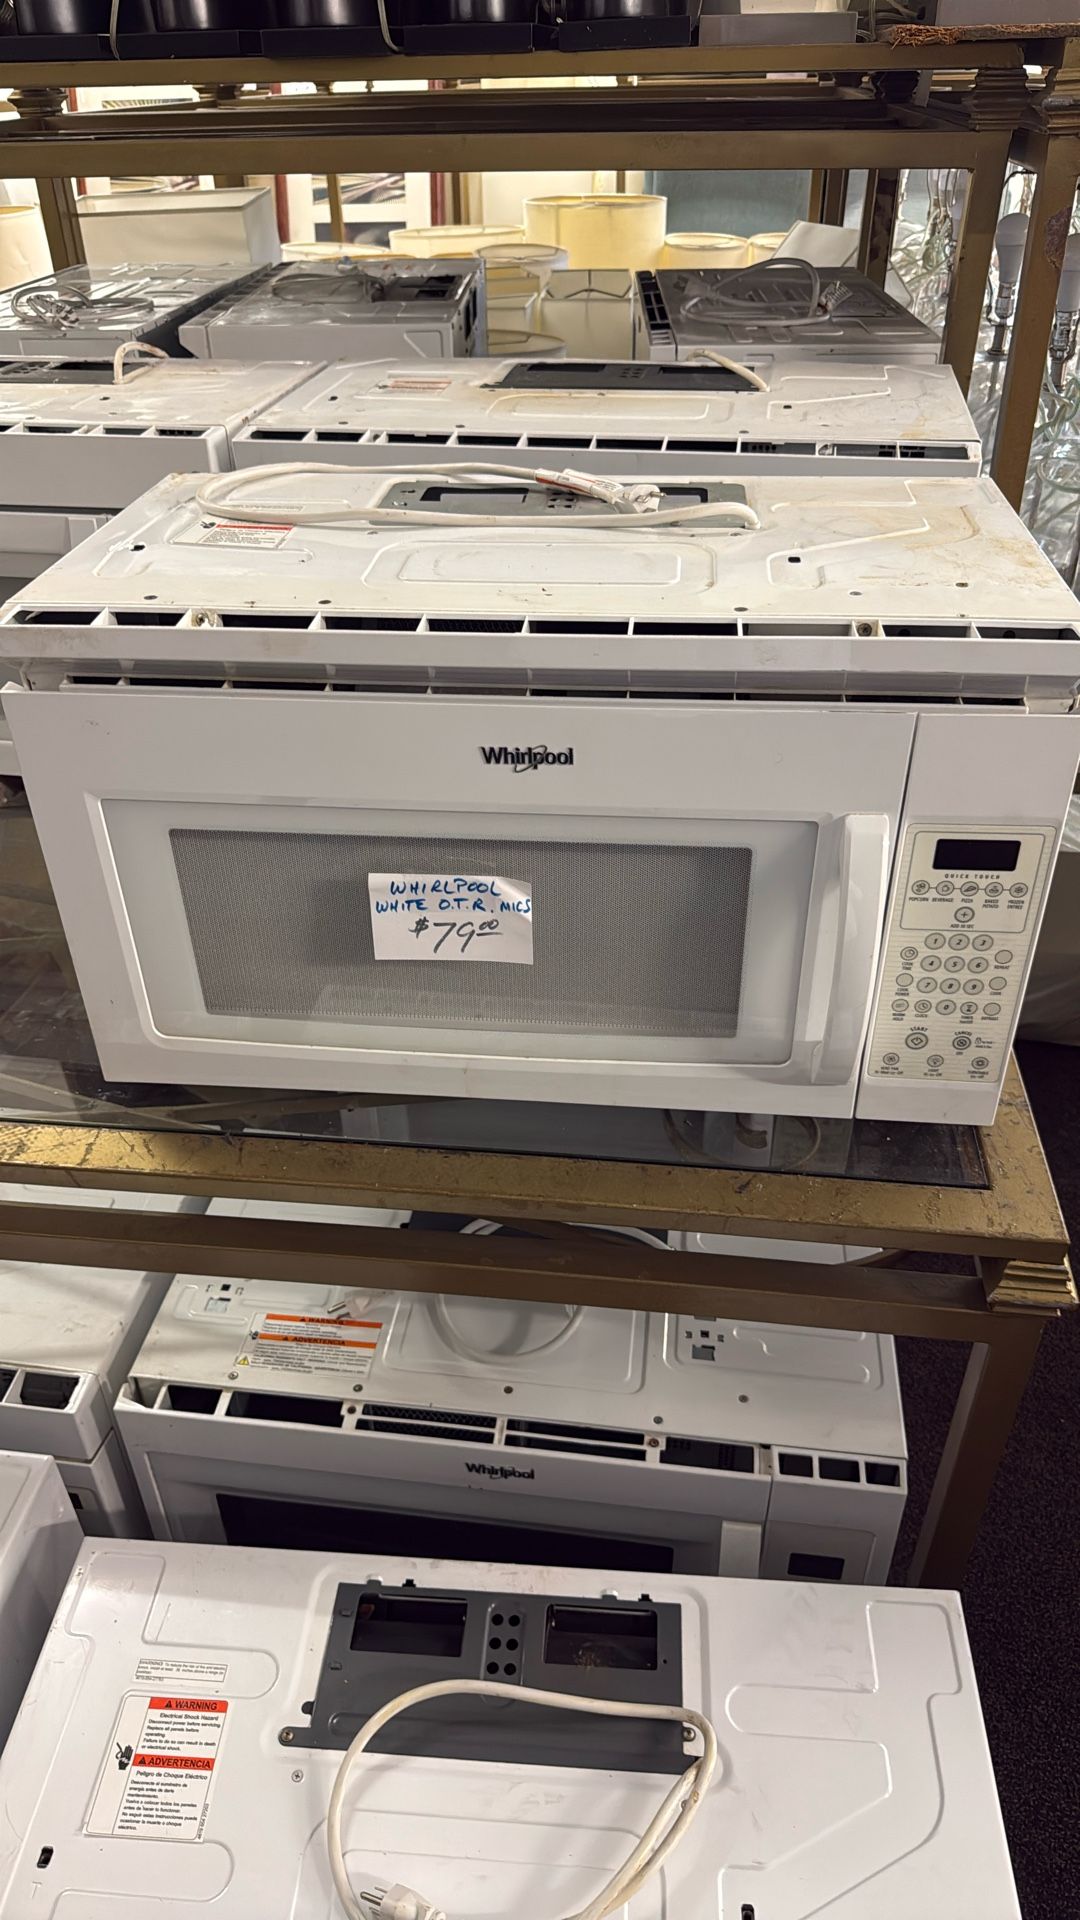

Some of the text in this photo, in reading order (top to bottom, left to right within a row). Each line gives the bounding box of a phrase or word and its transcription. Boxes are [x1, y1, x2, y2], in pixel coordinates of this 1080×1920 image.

[480, 745, 574, 772] Whirlpool
[390, 878, 502, 896] WHIRLPOOL
[375, 898, 531, 913] WHITE O.T.R. MICS
[465, 1462, 535, 1480] Whirlpool
[175, 1701, 218, 1711] WARNING
[150, 1757, 211, 1769] ADVERTENCIA
[136, 1770, 155, 1778] Peligro
[185, 1773, 208, 1781] Eléctrico
